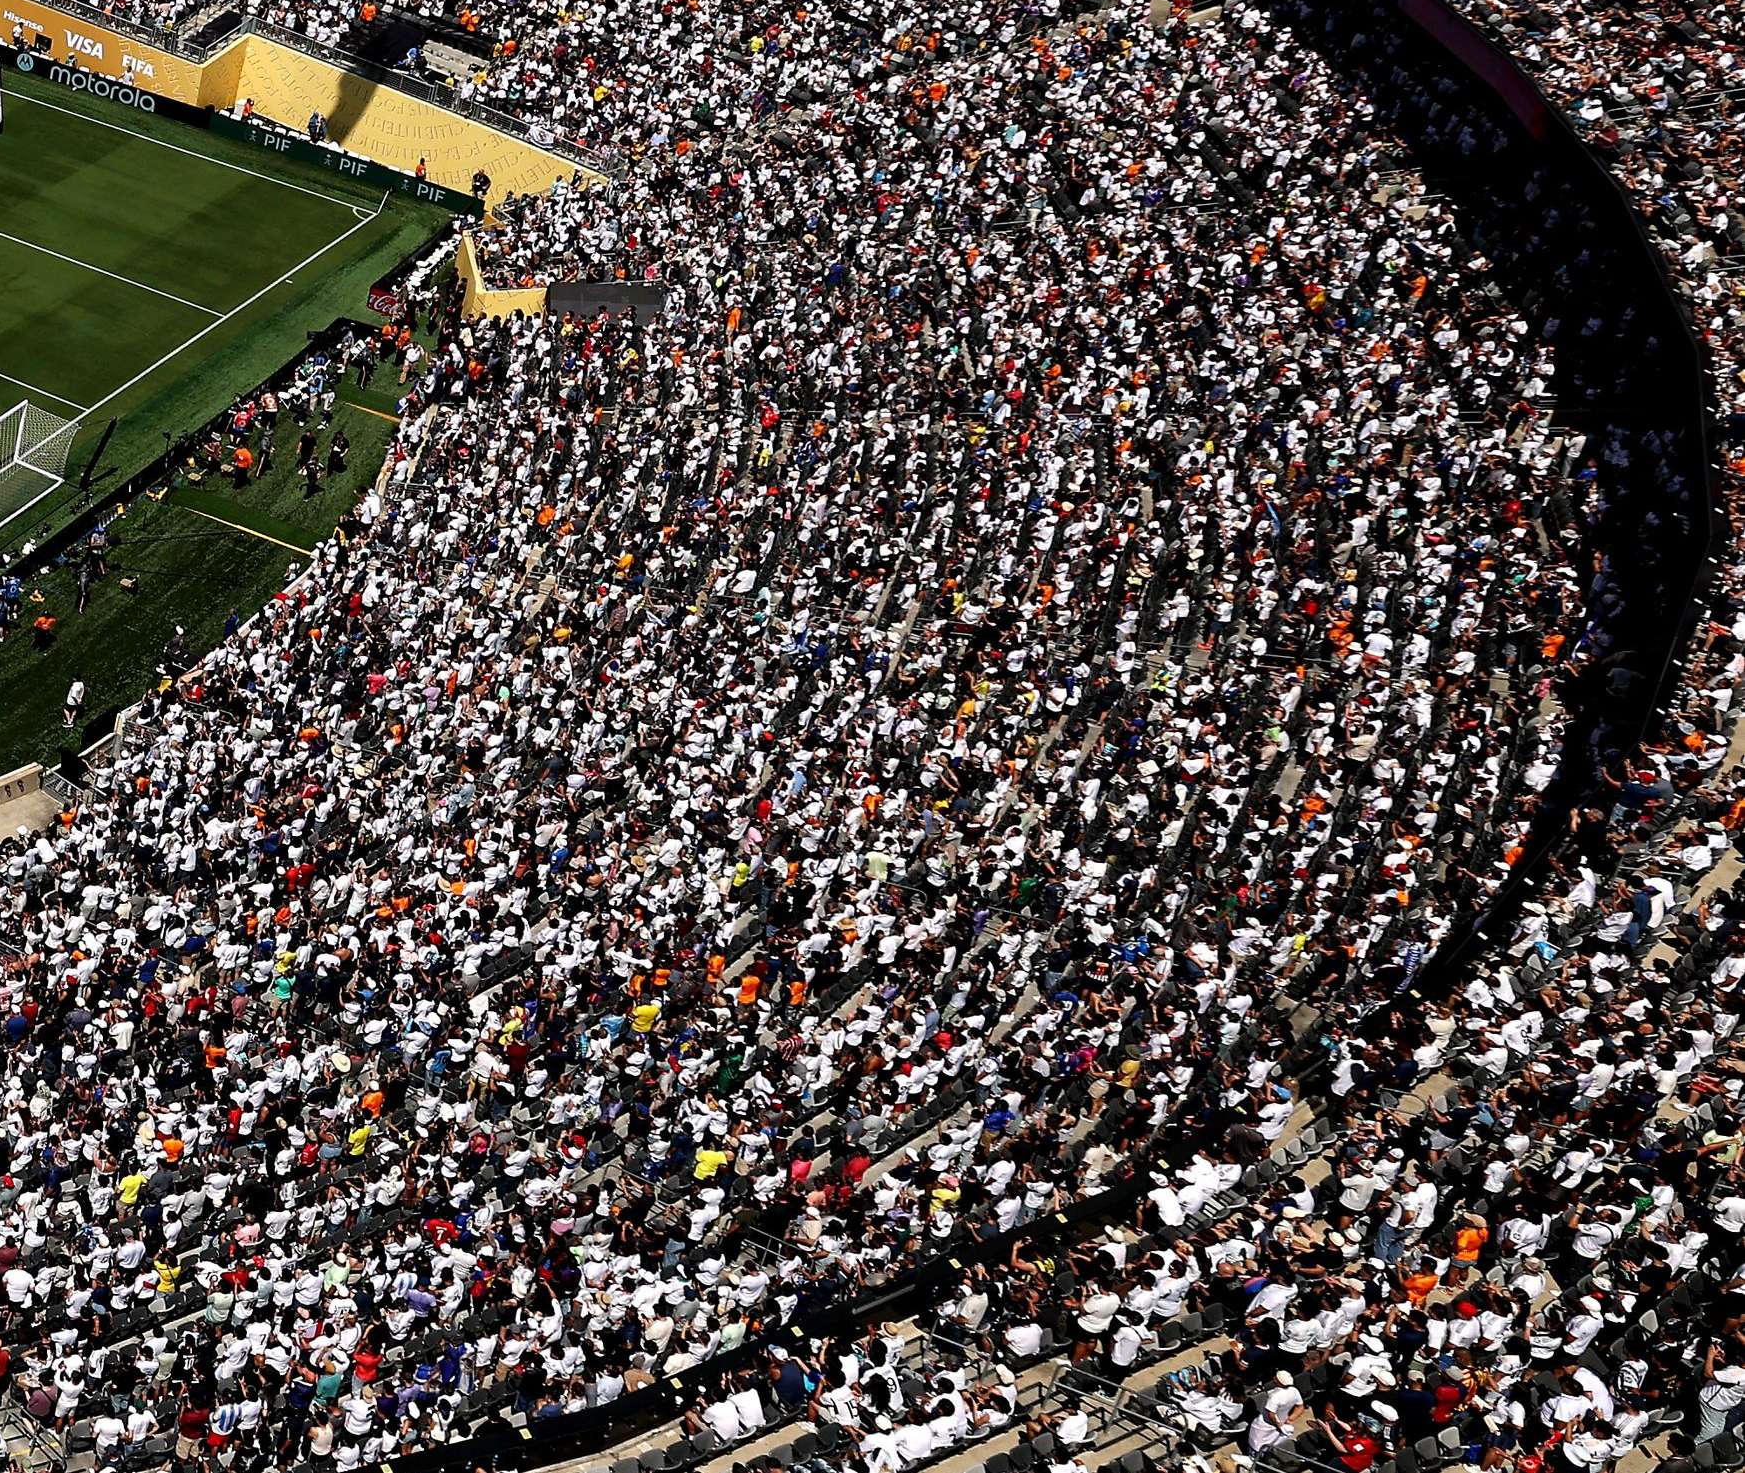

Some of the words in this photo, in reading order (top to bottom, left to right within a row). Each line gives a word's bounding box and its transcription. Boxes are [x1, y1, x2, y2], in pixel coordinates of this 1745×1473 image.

[3, 9, 44, 32] Hisense
[63, 29, 105, 60] VISA
[122, 53, 155, 78] FIFA
[49, 65, 156, 113] motorola
[263, 134, 292, 154] PIF
[338, 157, 368, 178] PIF
[416, 182, 446, 203] PIF
